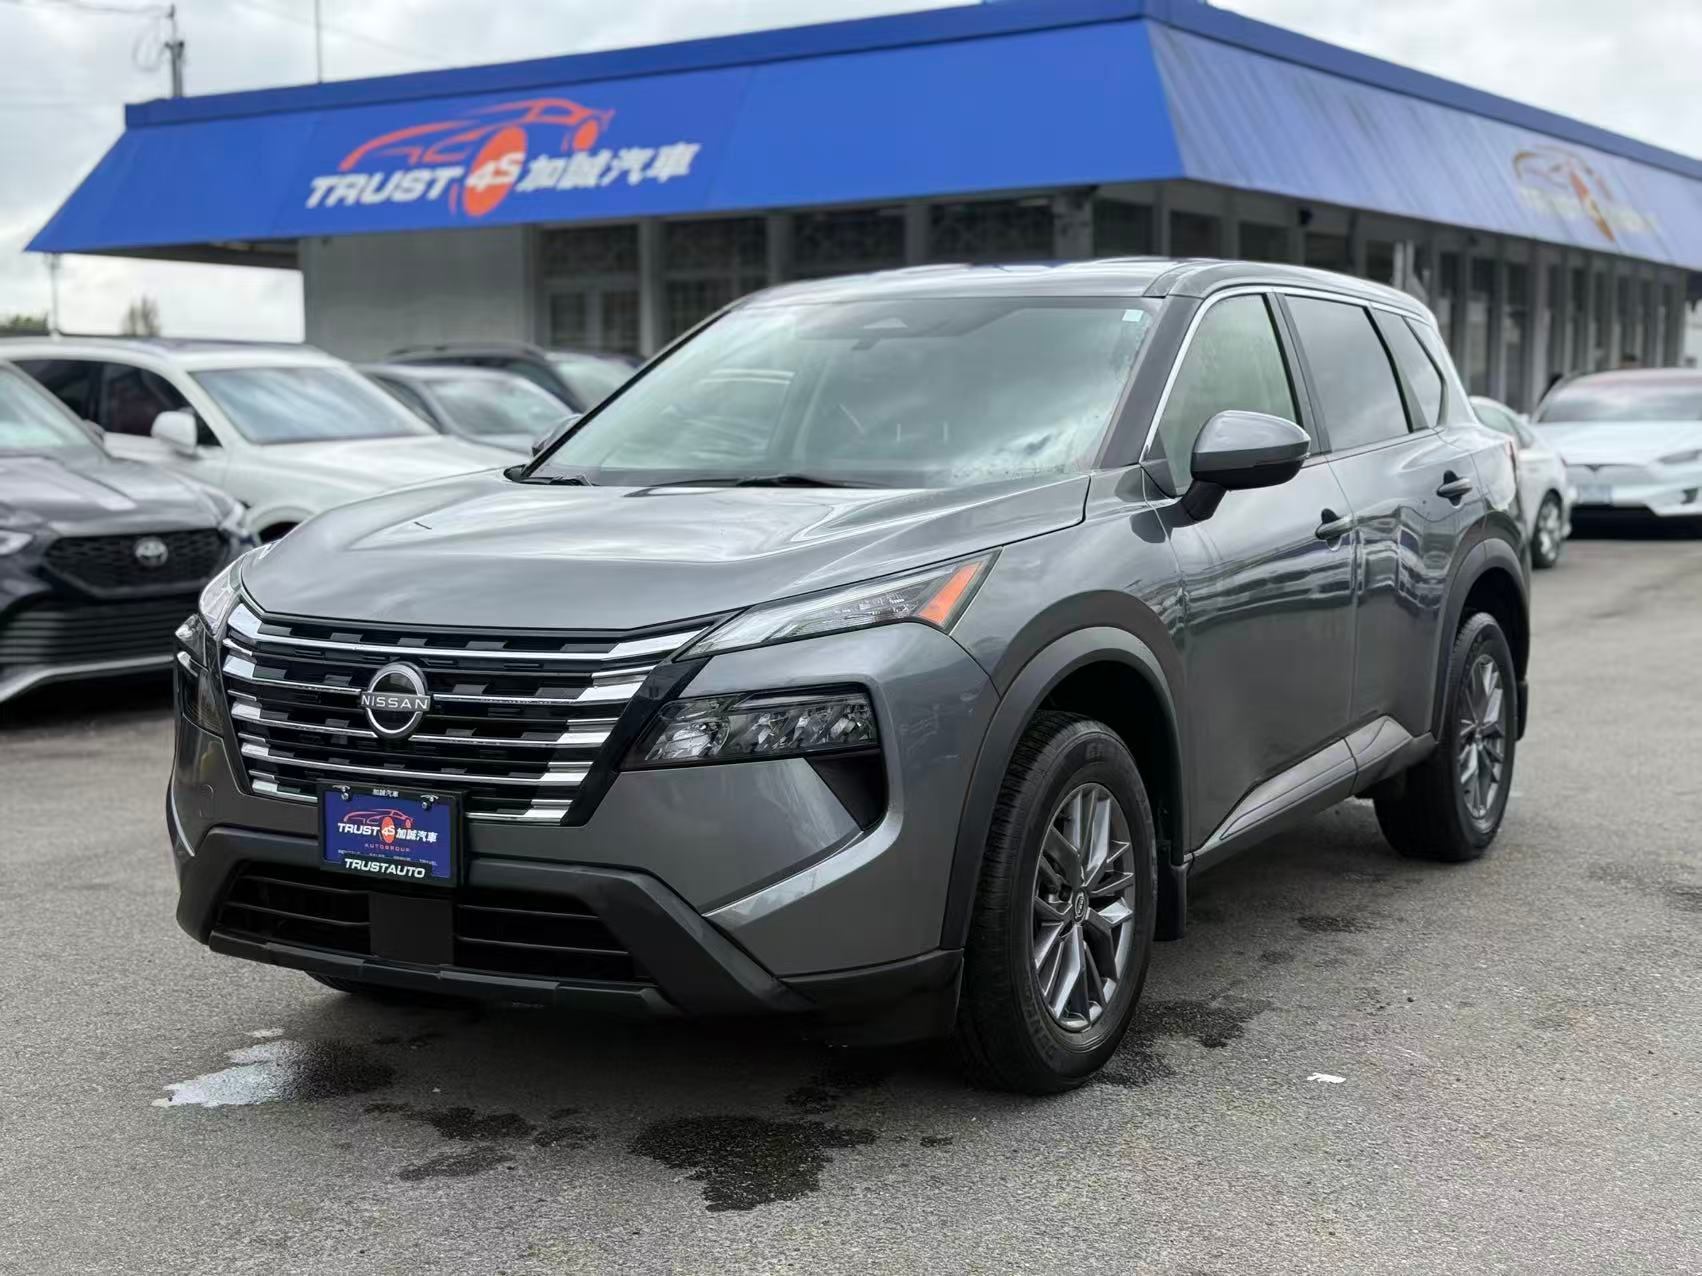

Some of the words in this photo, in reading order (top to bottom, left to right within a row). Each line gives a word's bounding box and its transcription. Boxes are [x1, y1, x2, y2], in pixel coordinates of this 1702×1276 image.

[306, 168, 465, 208] TRUST
[361, 694, 428, 709] NISSAN
[337, 823, 380, 836] TRUST
[344, 858, 425, 878] TRUSTAUTO
